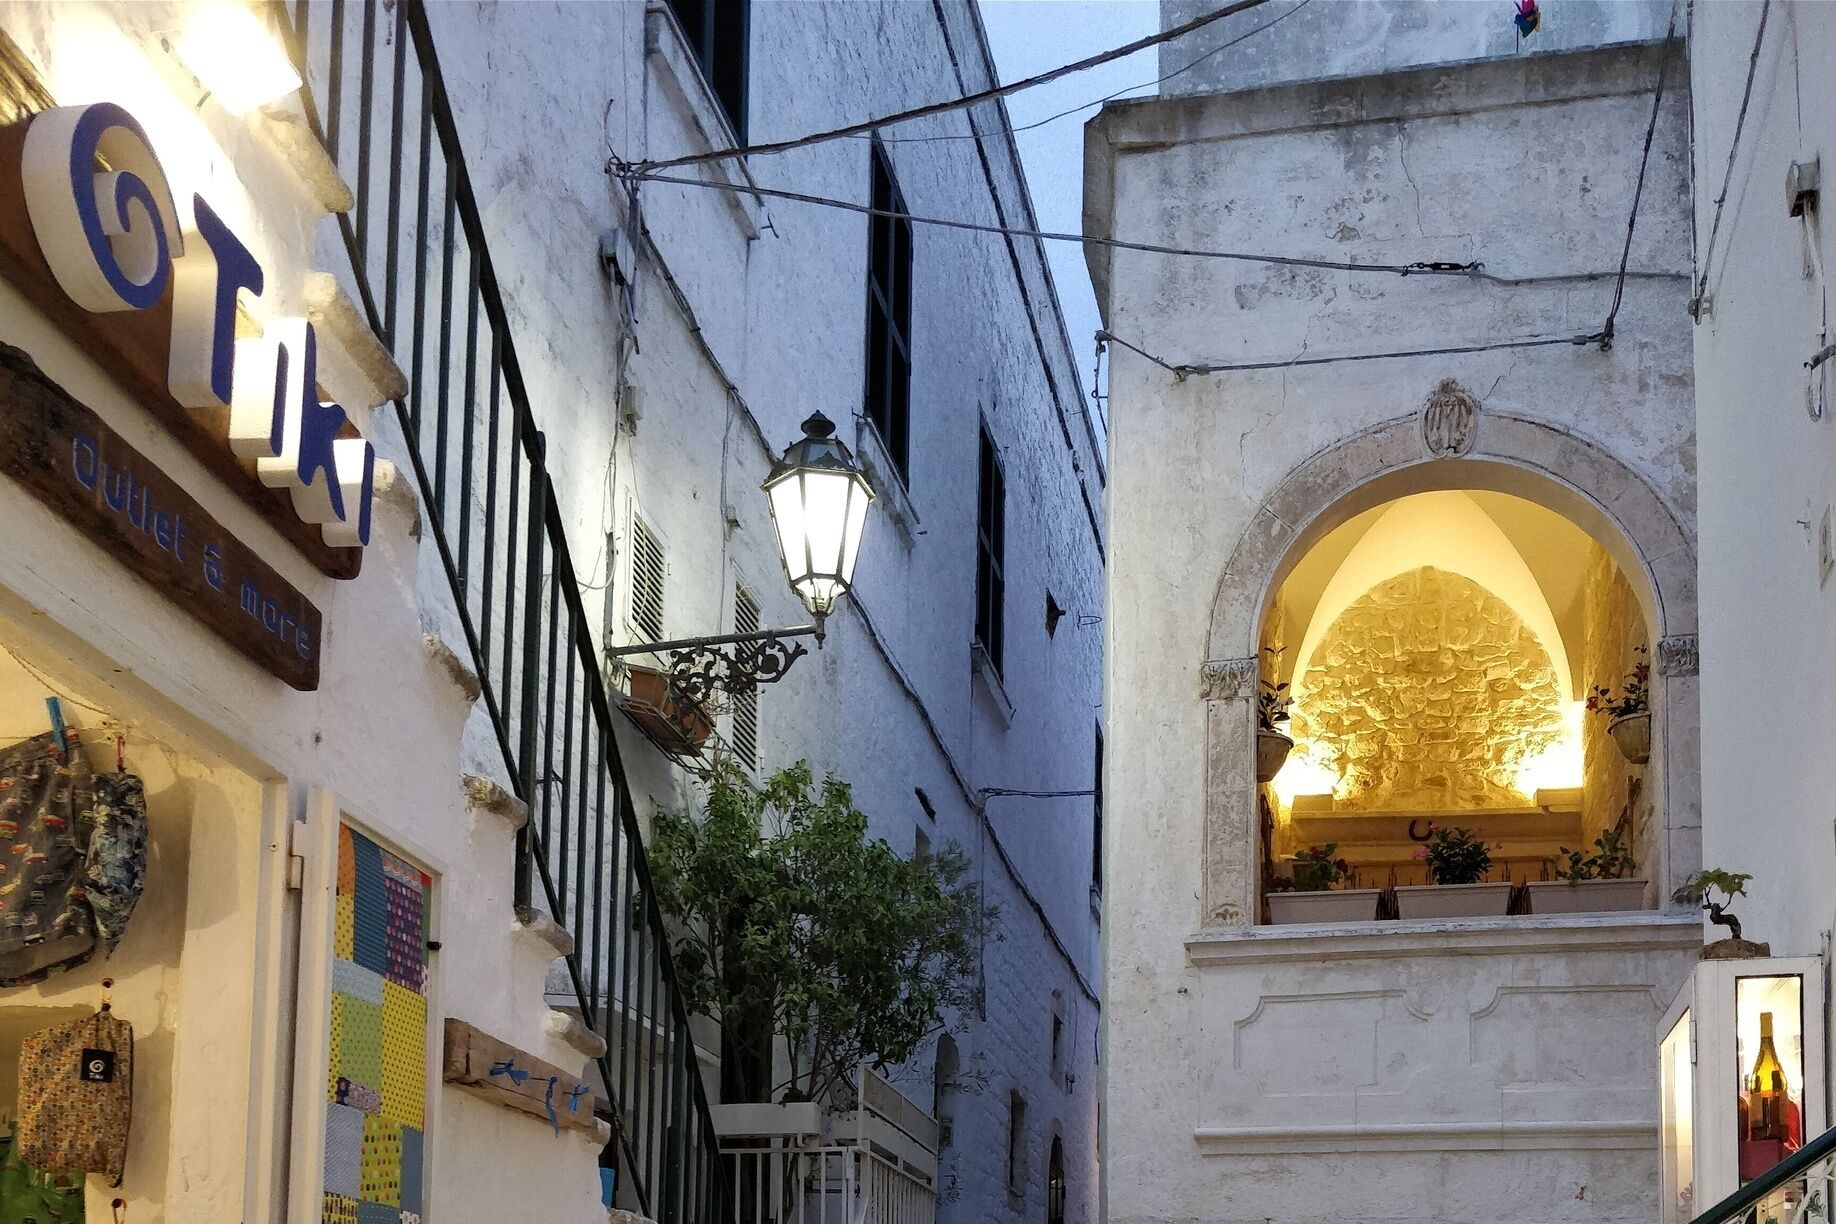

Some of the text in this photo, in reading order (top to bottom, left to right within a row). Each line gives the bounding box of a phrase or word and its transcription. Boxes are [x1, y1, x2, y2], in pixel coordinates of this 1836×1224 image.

[73, 433, 312, 661] Outlet & more
